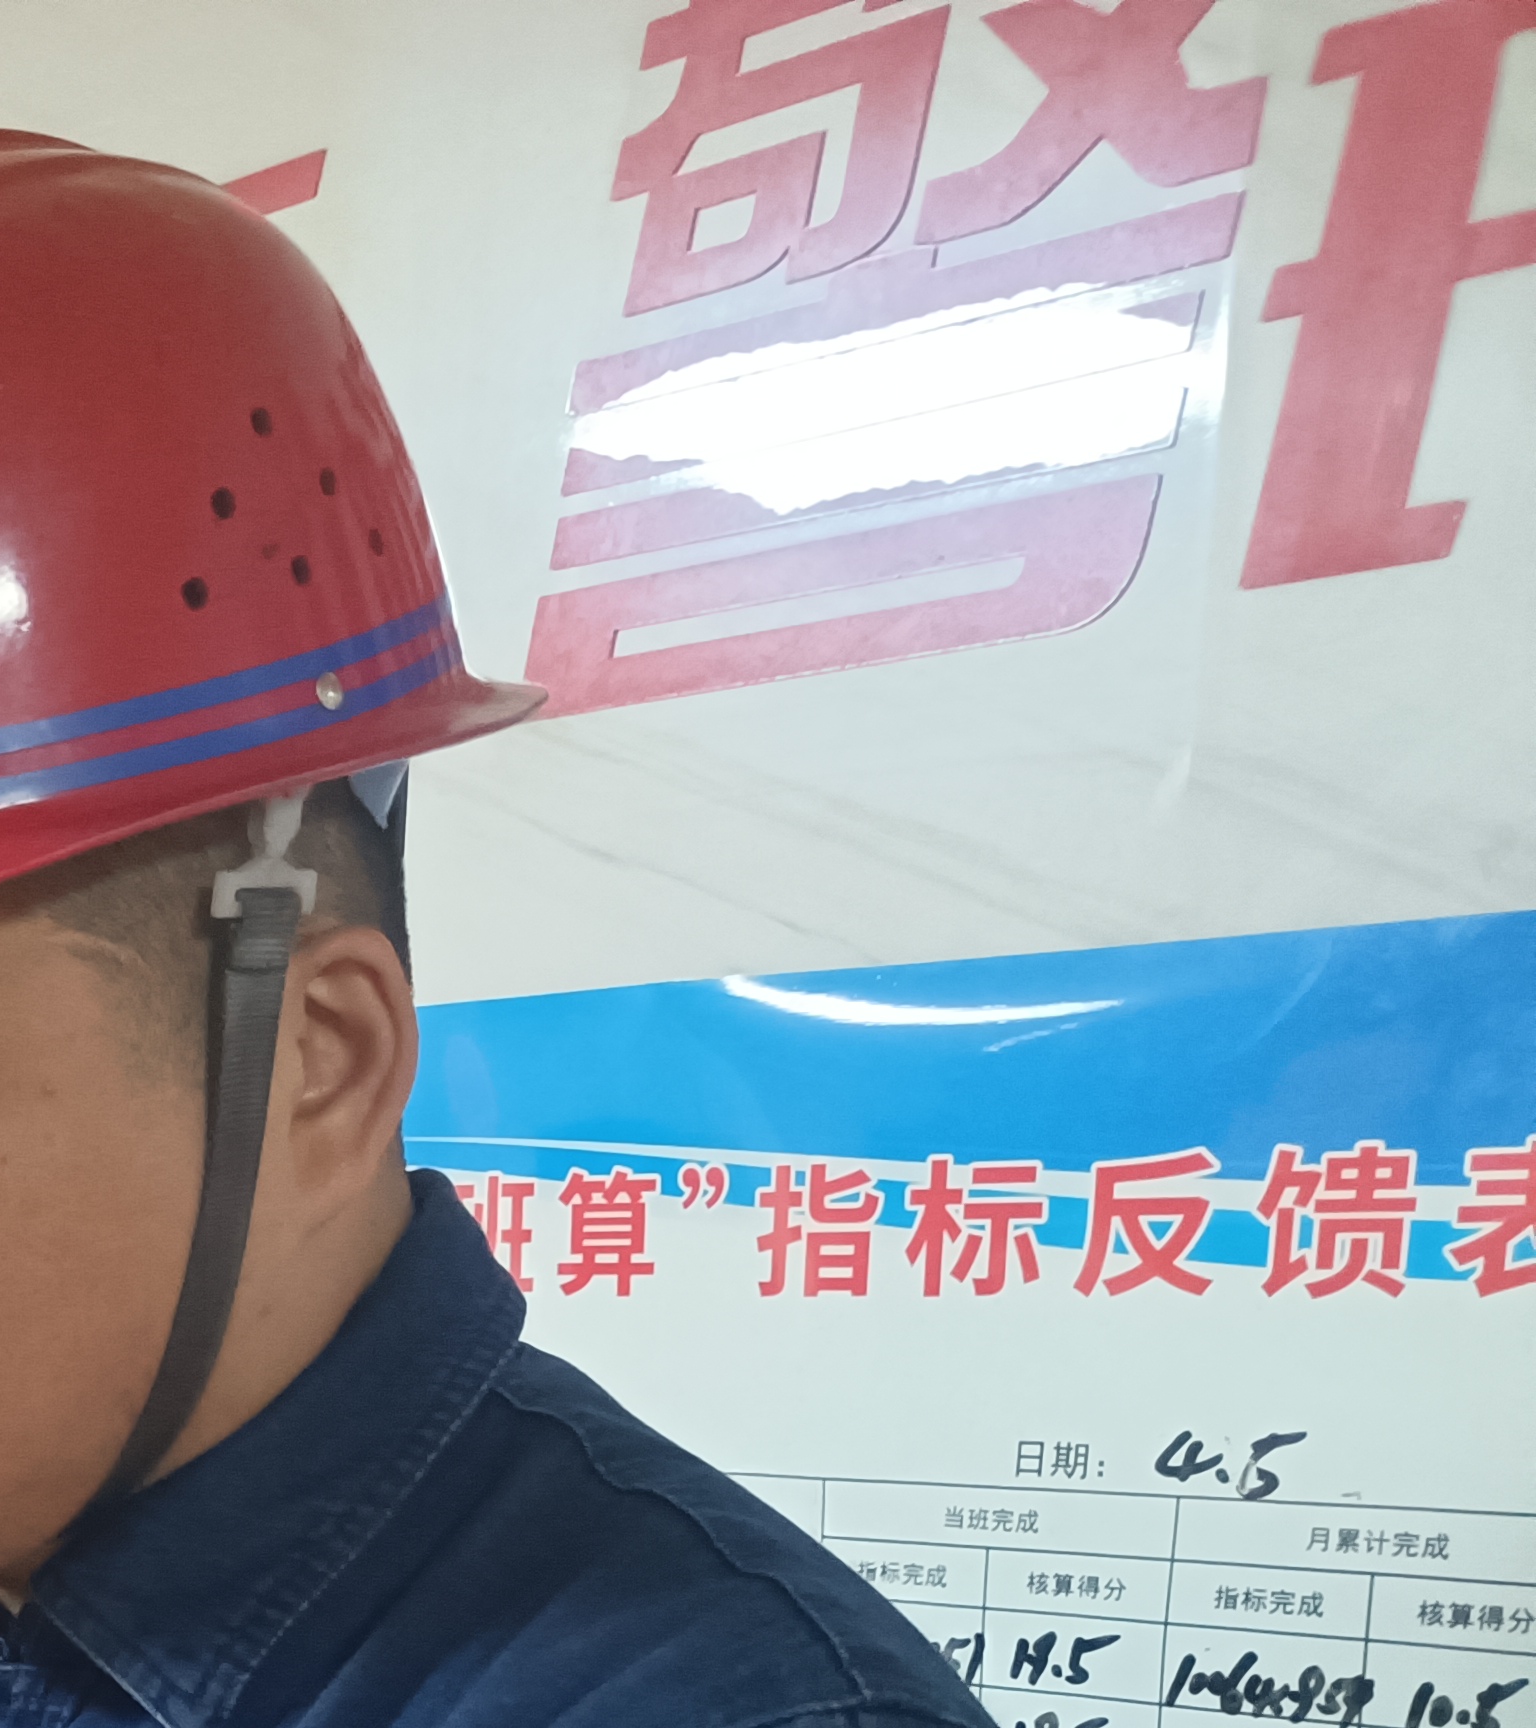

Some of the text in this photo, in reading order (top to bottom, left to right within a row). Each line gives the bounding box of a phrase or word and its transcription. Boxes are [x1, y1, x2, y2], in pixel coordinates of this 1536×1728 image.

[1015, 1440, 1107, 1480] 日期：
[1154, 1429, 1308, 1500] 4.5
[943, 1506, 1040, 1535] 当班完成
[1306, 1527, 1451, 1561] 月累计完成
[857, 1561, 948, 1589] 指标完成
[1026, 1572, 1128, 1603] 核算得分
[1213, 1586, 1325, 1619] 指标完成
[1417, 1601, 1536, 1635] 核算得分
